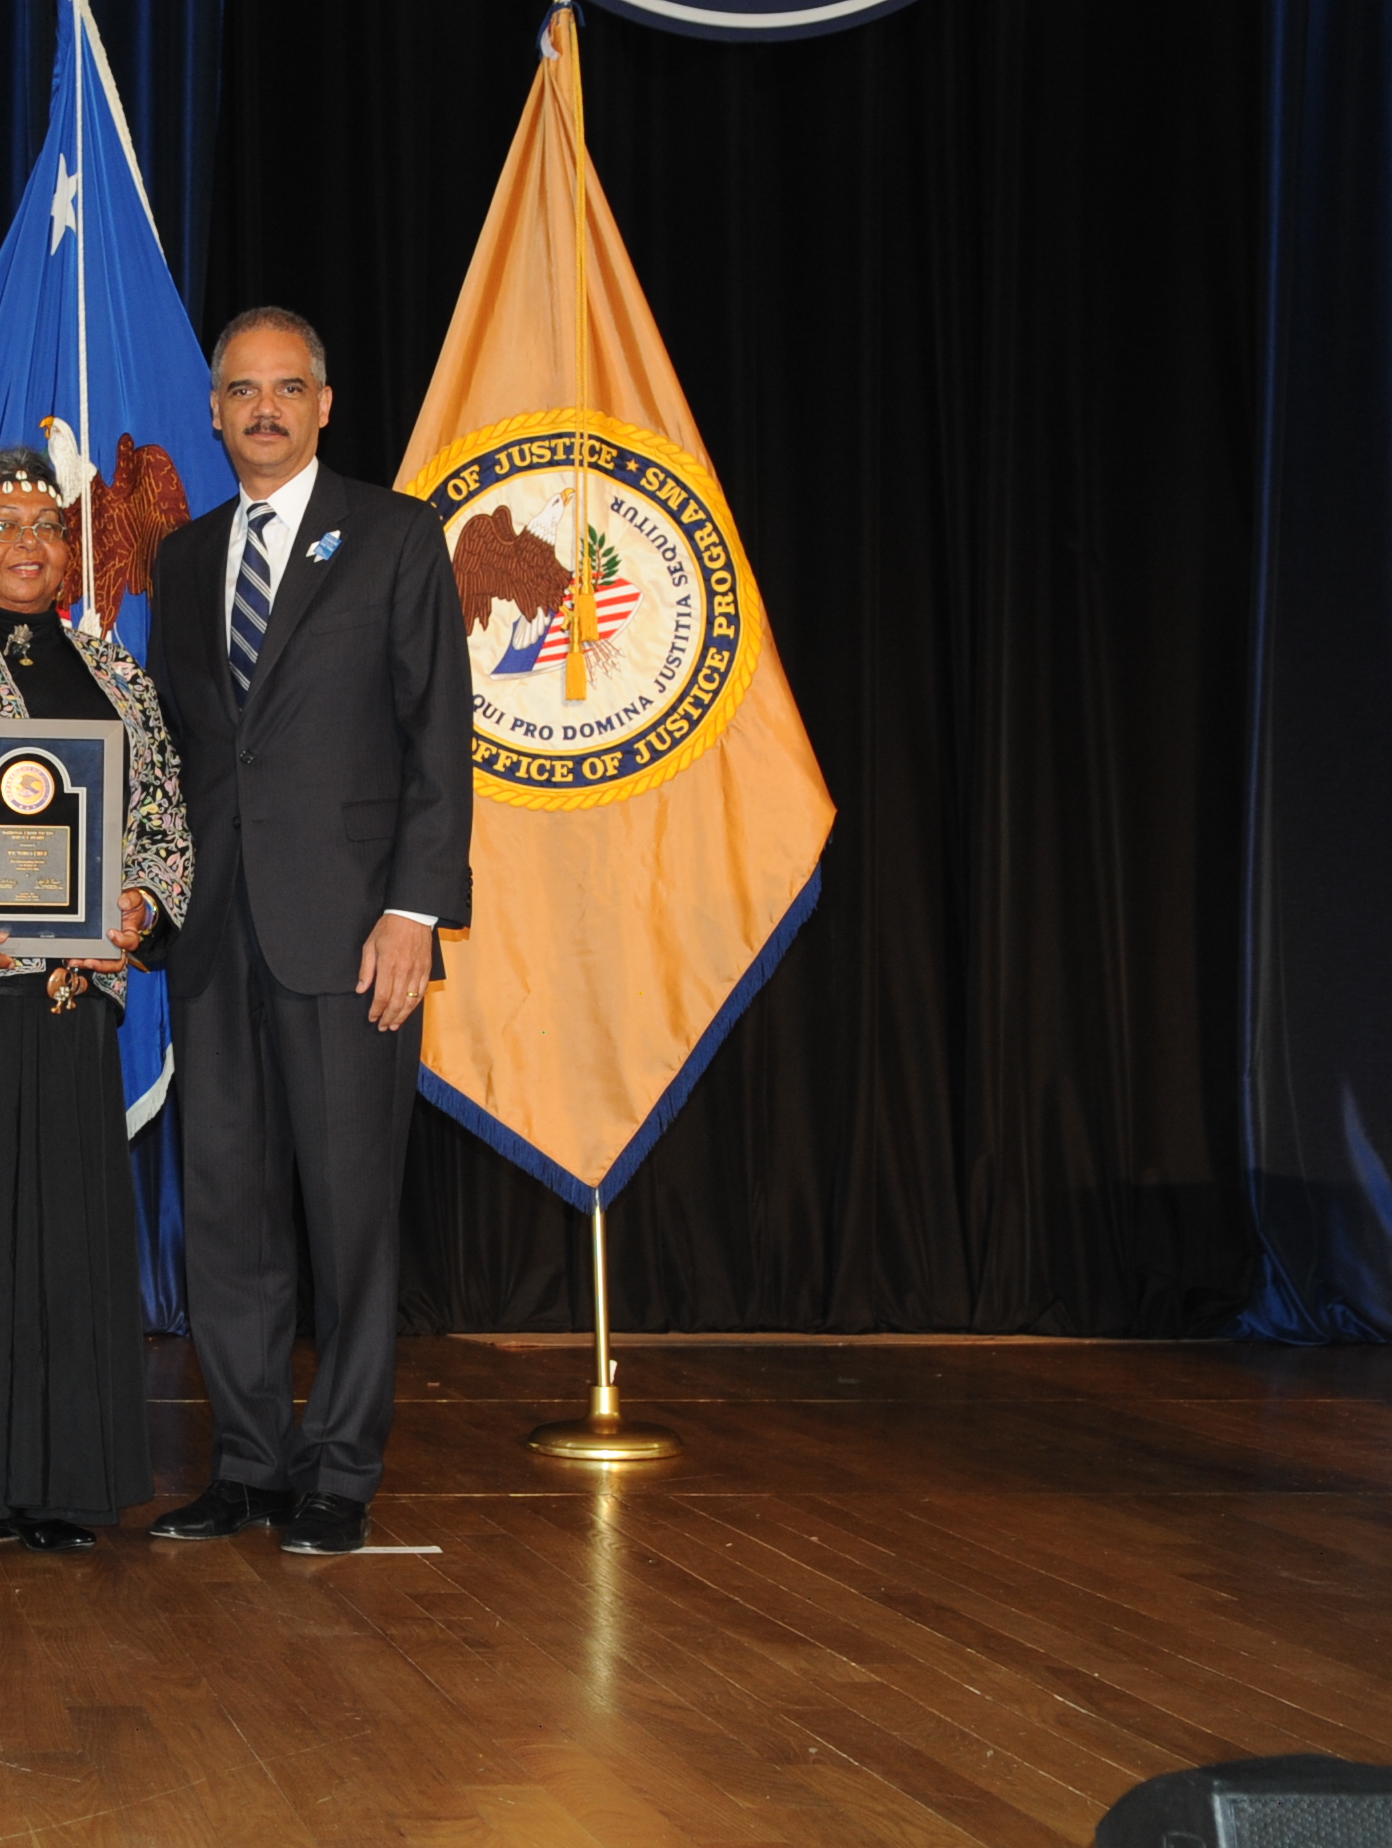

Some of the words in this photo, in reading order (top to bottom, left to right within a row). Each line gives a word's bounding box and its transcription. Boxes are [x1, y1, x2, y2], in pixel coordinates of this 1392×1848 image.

[447, 464, 481, 501] OF
[494, 437, 618, 475] JUSTICE
[610, 495, 688, 588] SEQUITUR
[639, 467, 736, 639] PROGRAMS
[653, 593, 692, 694] JUSTITIA
[473, 693, 506, 725] QUI
[510, 716, 554, 741] PRO
[562, 695, 655, 741] DOMINA
[633, 647, 730, 764] JUSTICE
[582, 751, 623, 780] OF
